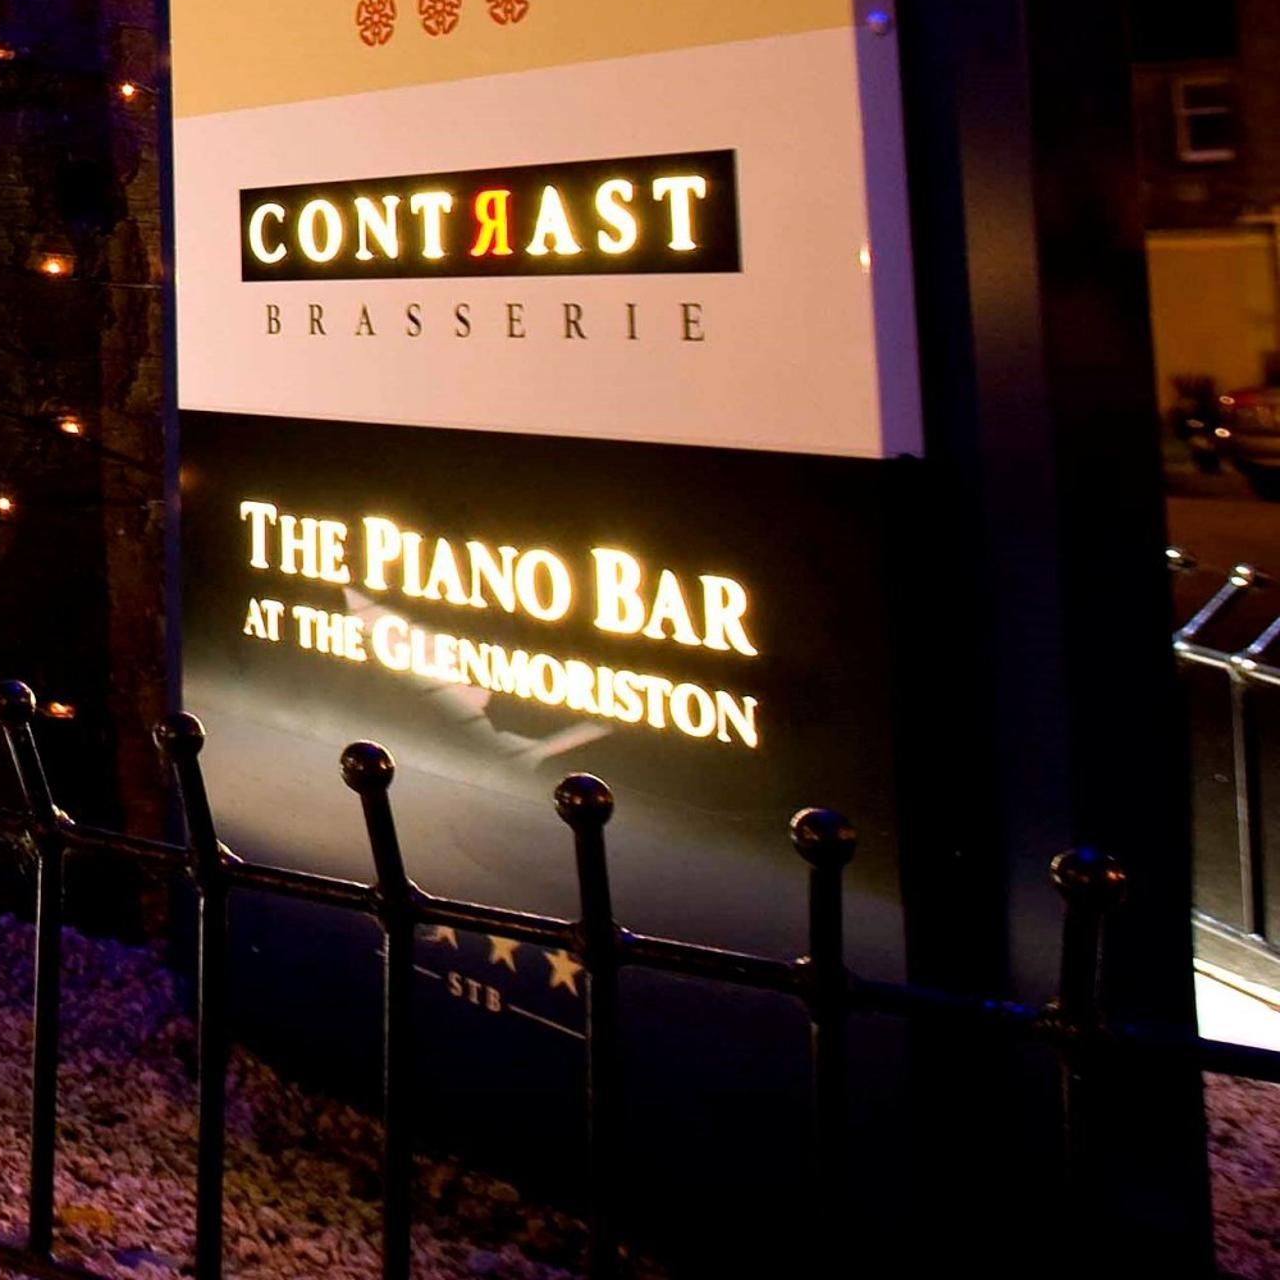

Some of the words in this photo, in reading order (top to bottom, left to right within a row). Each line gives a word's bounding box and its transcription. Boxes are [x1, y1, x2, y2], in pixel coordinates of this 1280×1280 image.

[265, 301, 706, 342] BRASSERIE
[240, 500, 351, 585] THE
[362, 516, 572, 622] PIANO
[590, 547, 760, 657] BAR
[243, 597, 285, 642] AT
[292, 603, 367, 662] THE
[370, 613, 760, 749] GLENMORISTON
[447, 970, 502, 1014] STB
